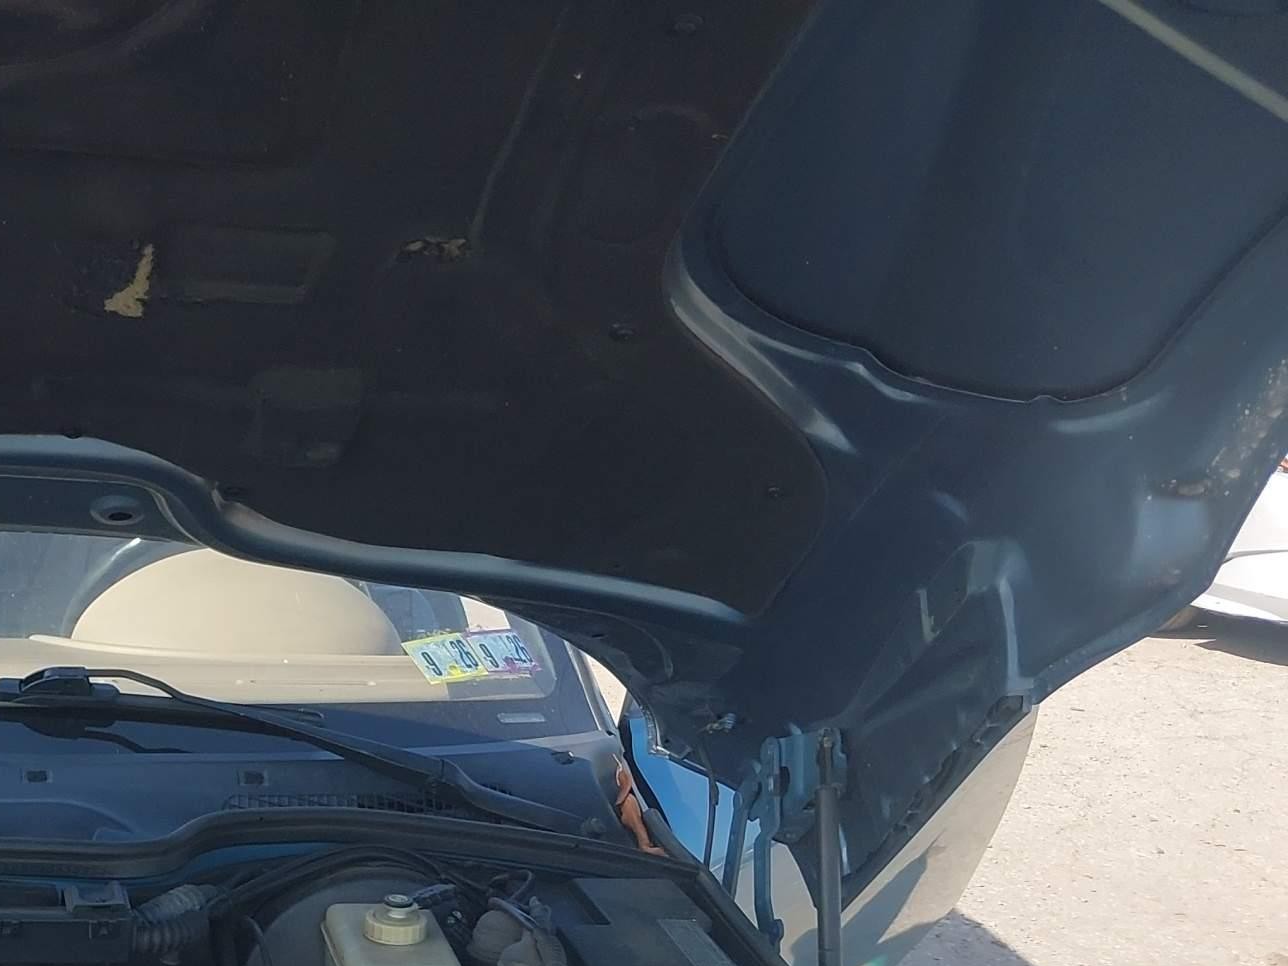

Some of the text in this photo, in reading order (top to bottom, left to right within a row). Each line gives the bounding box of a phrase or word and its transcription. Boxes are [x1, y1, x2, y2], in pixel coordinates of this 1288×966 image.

[420, 639, 480, 677] 9 26
[478, 643, 500, 669] 9
